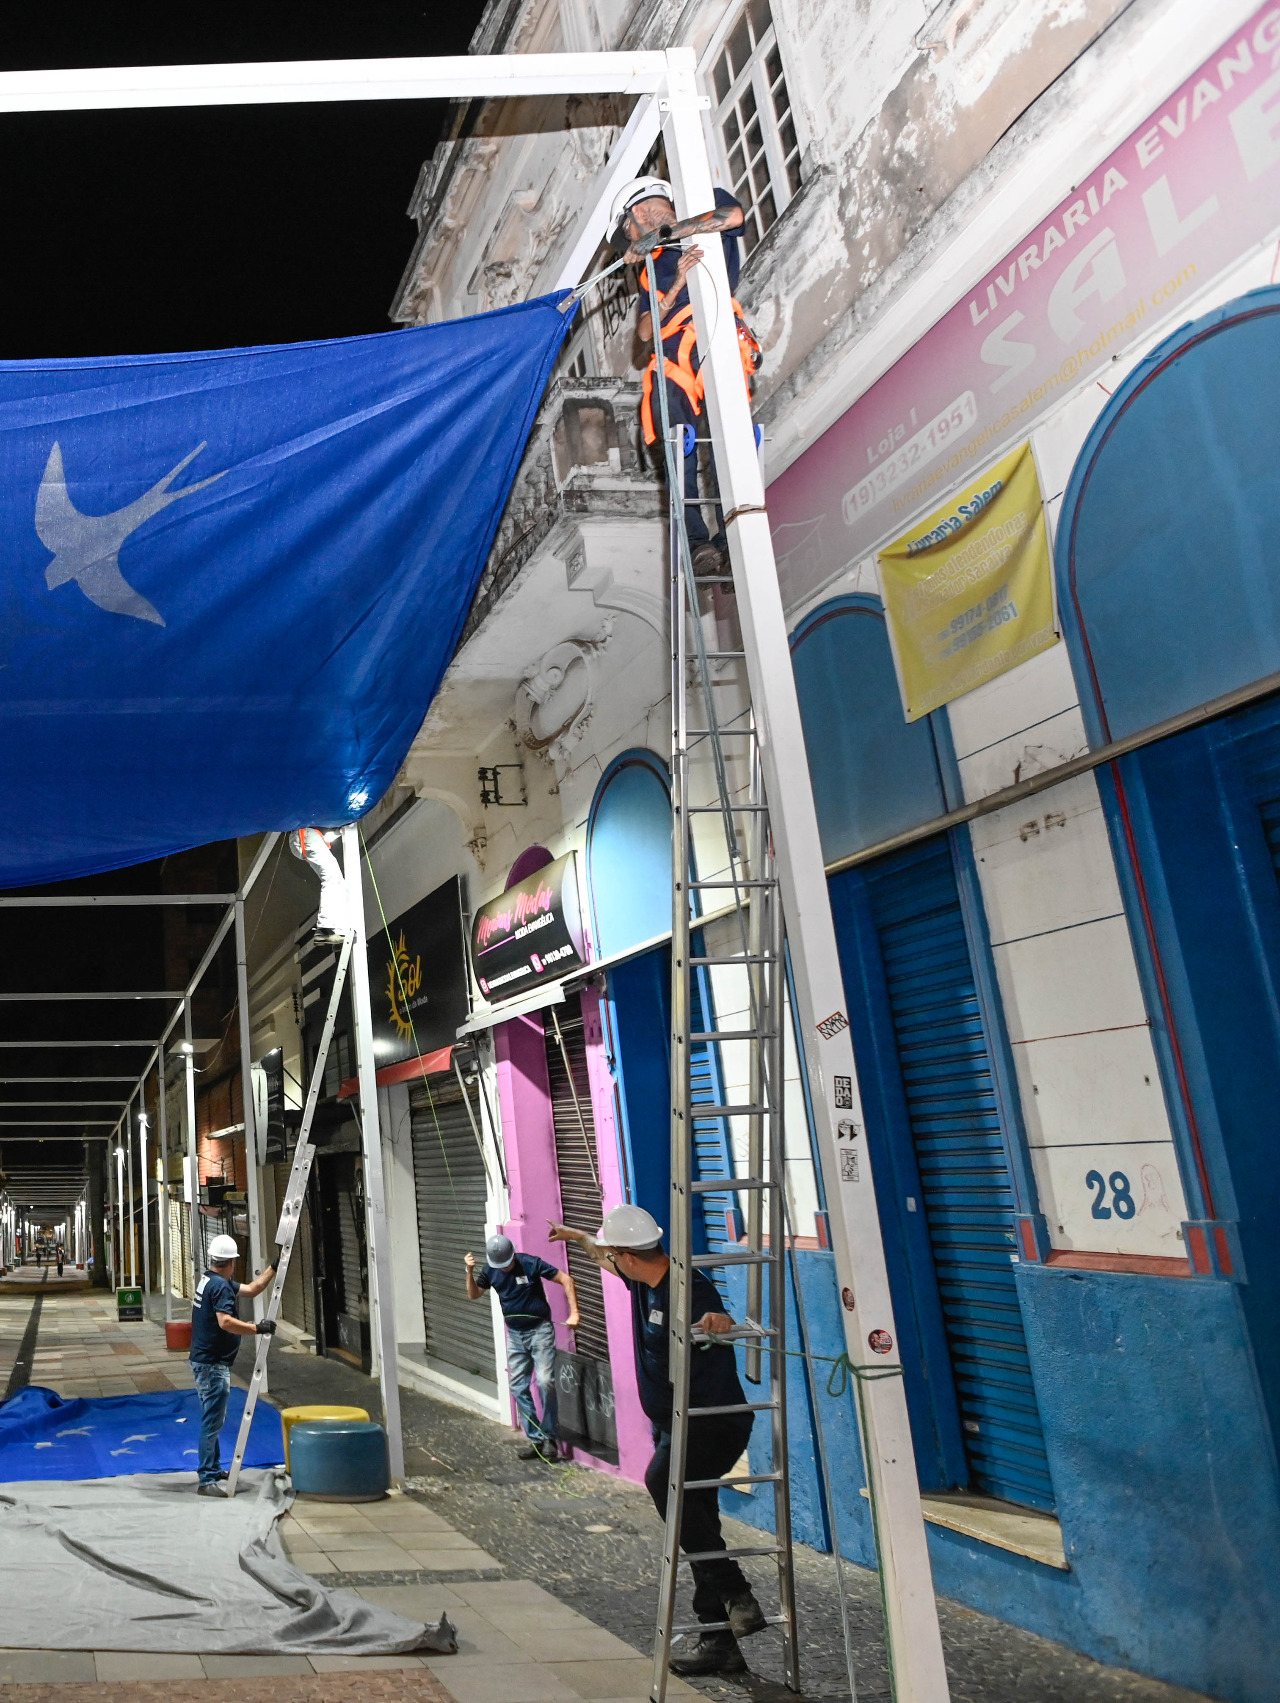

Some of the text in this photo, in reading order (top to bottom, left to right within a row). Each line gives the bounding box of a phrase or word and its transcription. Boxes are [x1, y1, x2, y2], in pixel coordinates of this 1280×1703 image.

[968, 170, 1128, 327] LIVRARIA
[844, 396, 976, 523] (19)3232-1951
[867, 422, 906, 464] Loja
[907, 515, 963, 556] Livraria
[957, 479, 1004, 523] Salem
[1085, 1169, 1136, 1220] 28
